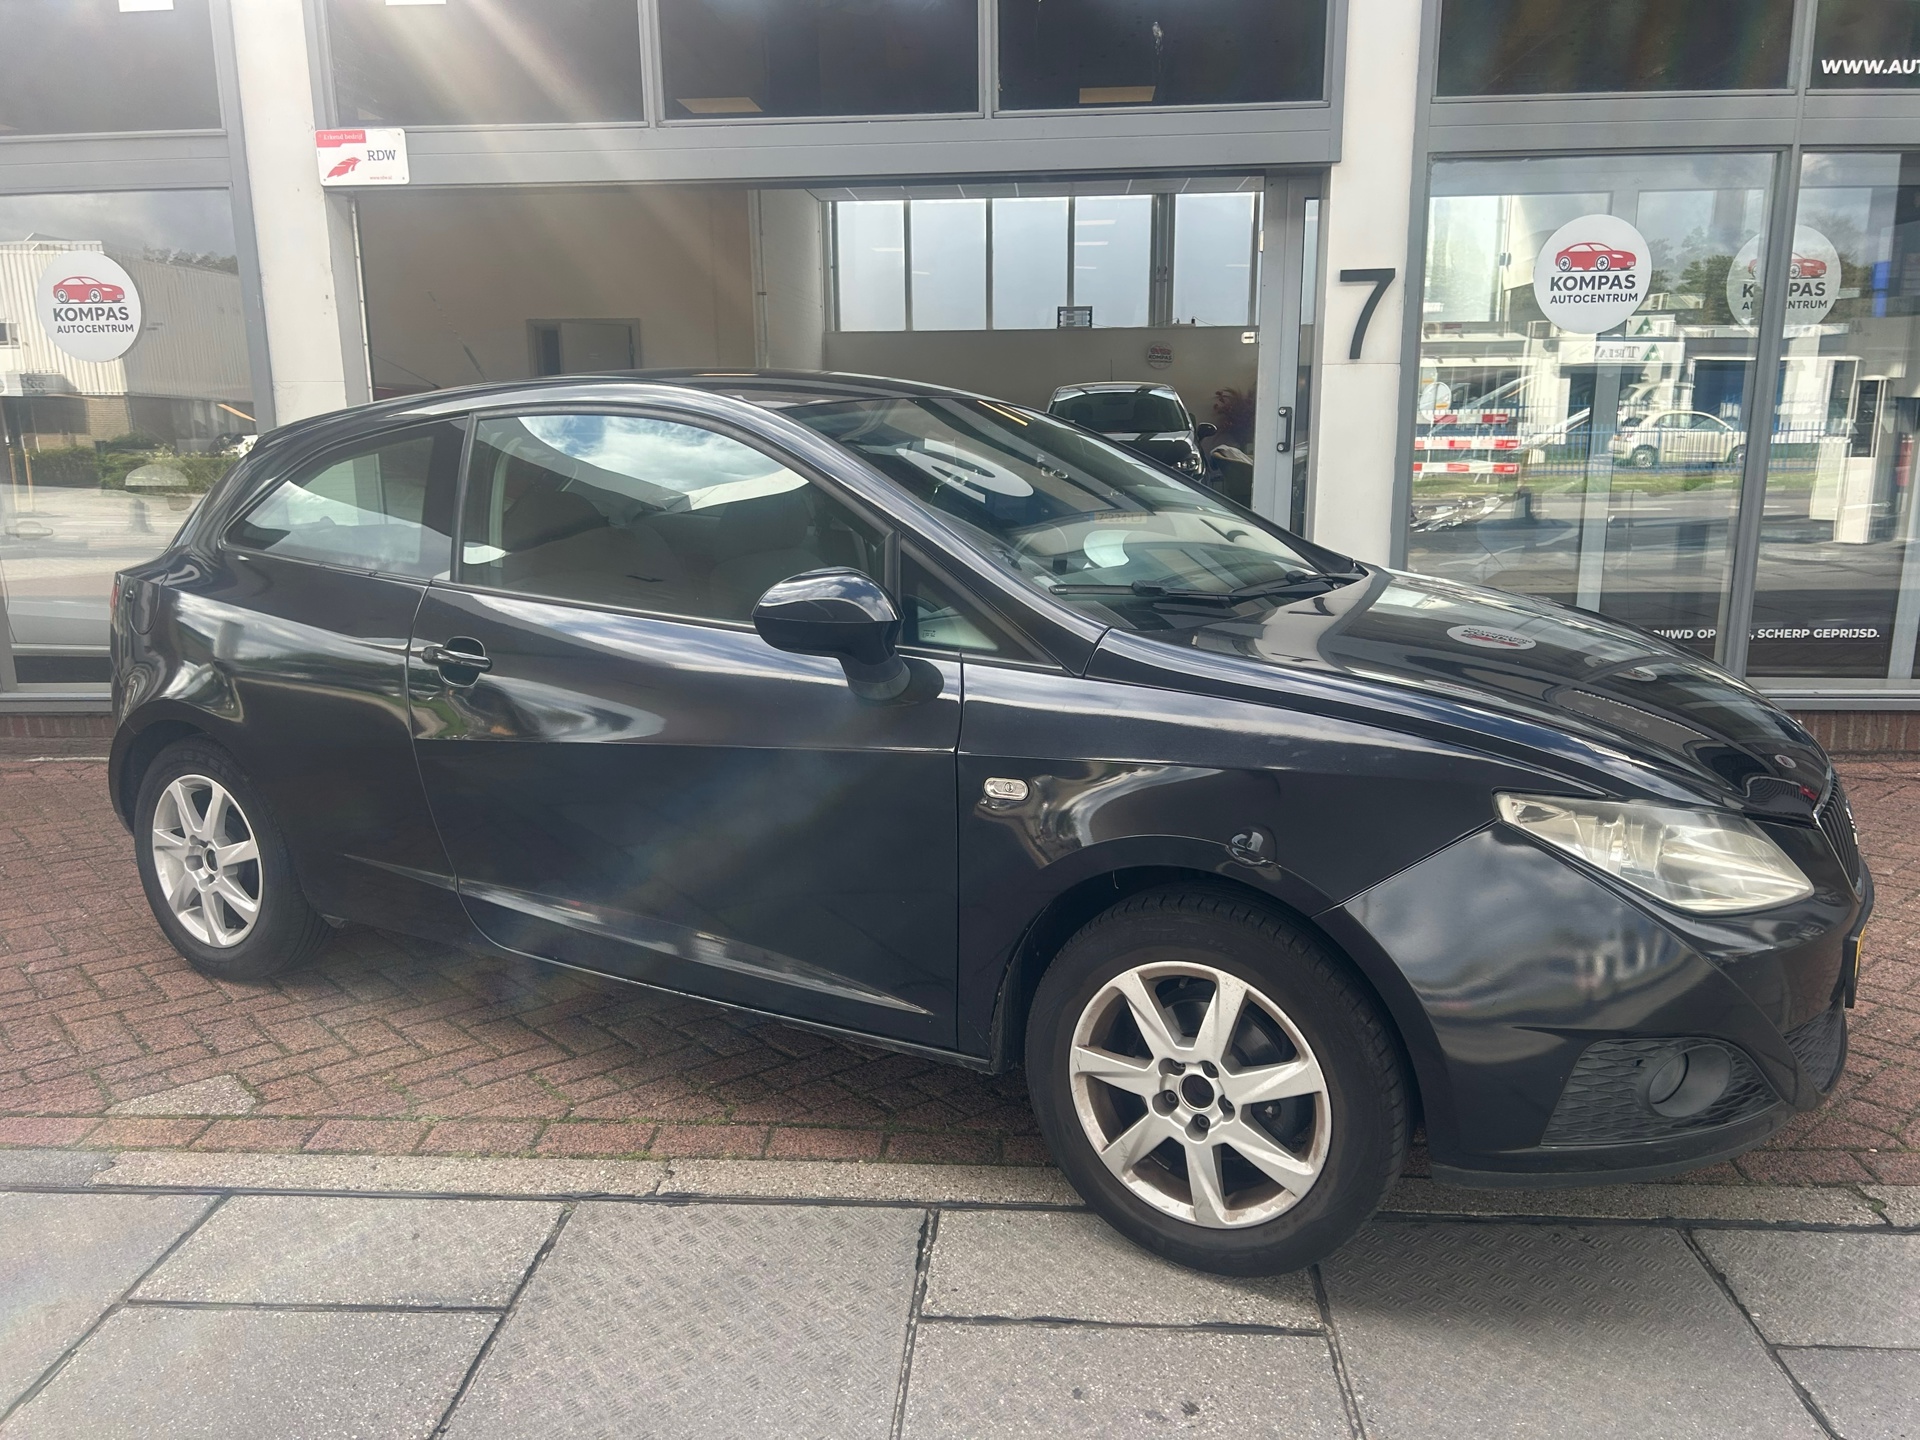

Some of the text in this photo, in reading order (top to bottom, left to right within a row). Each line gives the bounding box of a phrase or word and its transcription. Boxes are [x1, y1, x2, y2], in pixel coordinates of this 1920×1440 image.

[367, 149, 396, 161] RDW
[1550, 274, 1636, 292] KOMPAS
[1742, 281, 1826, 298] KPAS
[1549, 292, 1638, 304] AUTOCENTRUM
[53, 306, 130, 322] KOMPAS
[1340, 268, 1396, 359] 7
[56, 323, 135, 334] AUTOCENTRUM
[1697, 629, 1716, 639] OP
[1757, 628, 1810, 639] SCHERP
[1813, 628, 1880, 639] GEPRIJSD.
